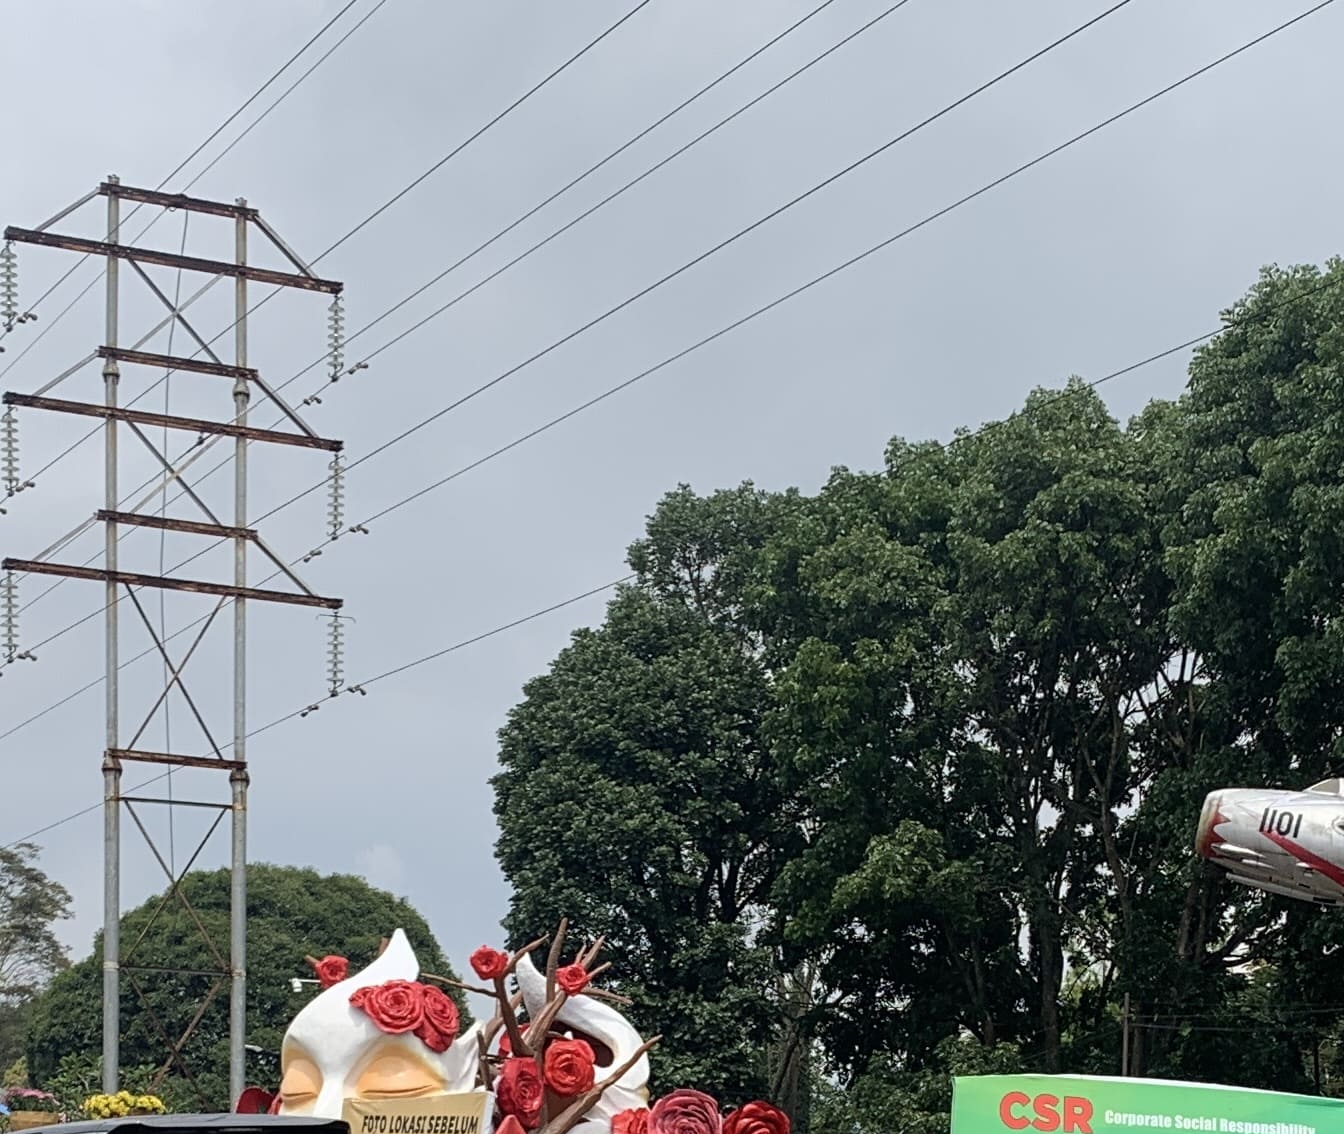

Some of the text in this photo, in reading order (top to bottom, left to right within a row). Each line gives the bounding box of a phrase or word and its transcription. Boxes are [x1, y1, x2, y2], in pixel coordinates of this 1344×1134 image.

[1259, 808, 1303, 838] 1101
[361, 1115, 479, 1134] FOTO LOKASI SEBELUM
[999, 1091, 1094, 1134] CSR
[1104, 1109, 1172, 1129] Corporate
[1174, 1114, 1217, 1132] Social
